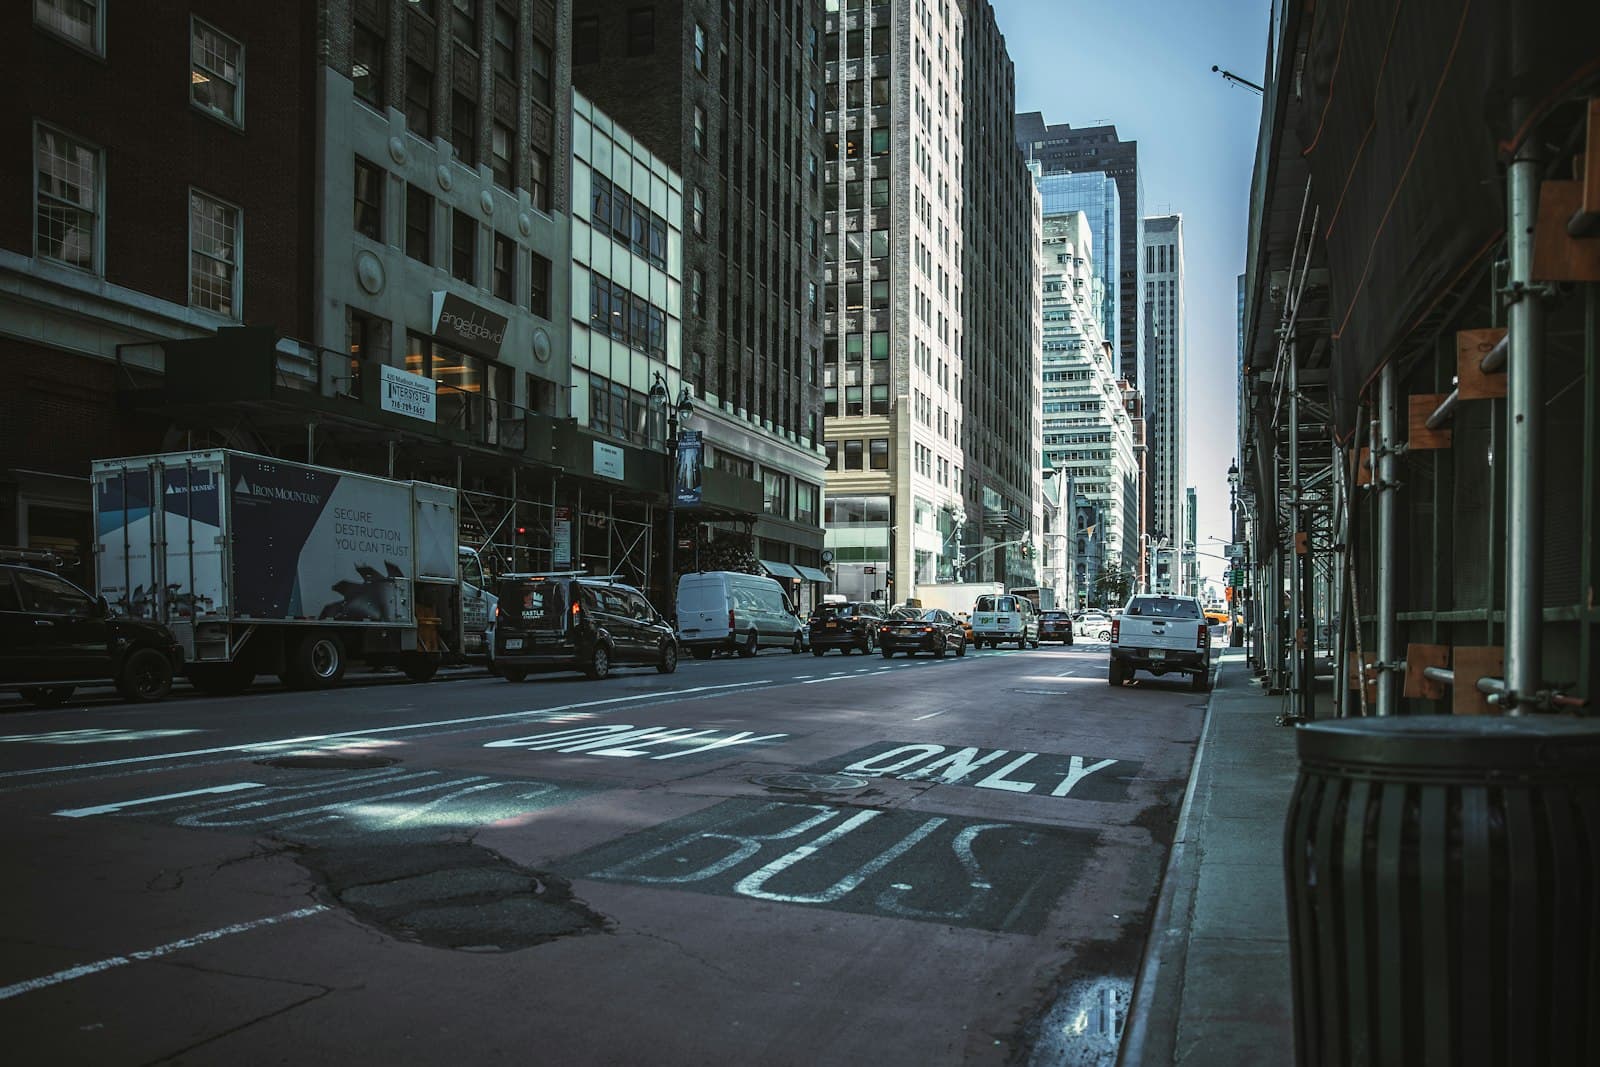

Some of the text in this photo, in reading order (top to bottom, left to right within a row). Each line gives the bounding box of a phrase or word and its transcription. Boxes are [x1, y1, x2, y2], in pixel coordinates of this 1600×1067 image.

[252, 483, 274, 497] IRON
[275, 486, 320, 505] MOUNTAIN
[334, 507, 373, 523] SECURE
[334, 523, 401, 542] DESTRUCTION
[334, 538, 409, 558] YOU CAN TRUST
[482, 723, 789, 761] ONLY
[842, 743, 1119, 798] ONLY
[586, 801, 1022, 919] BUS
